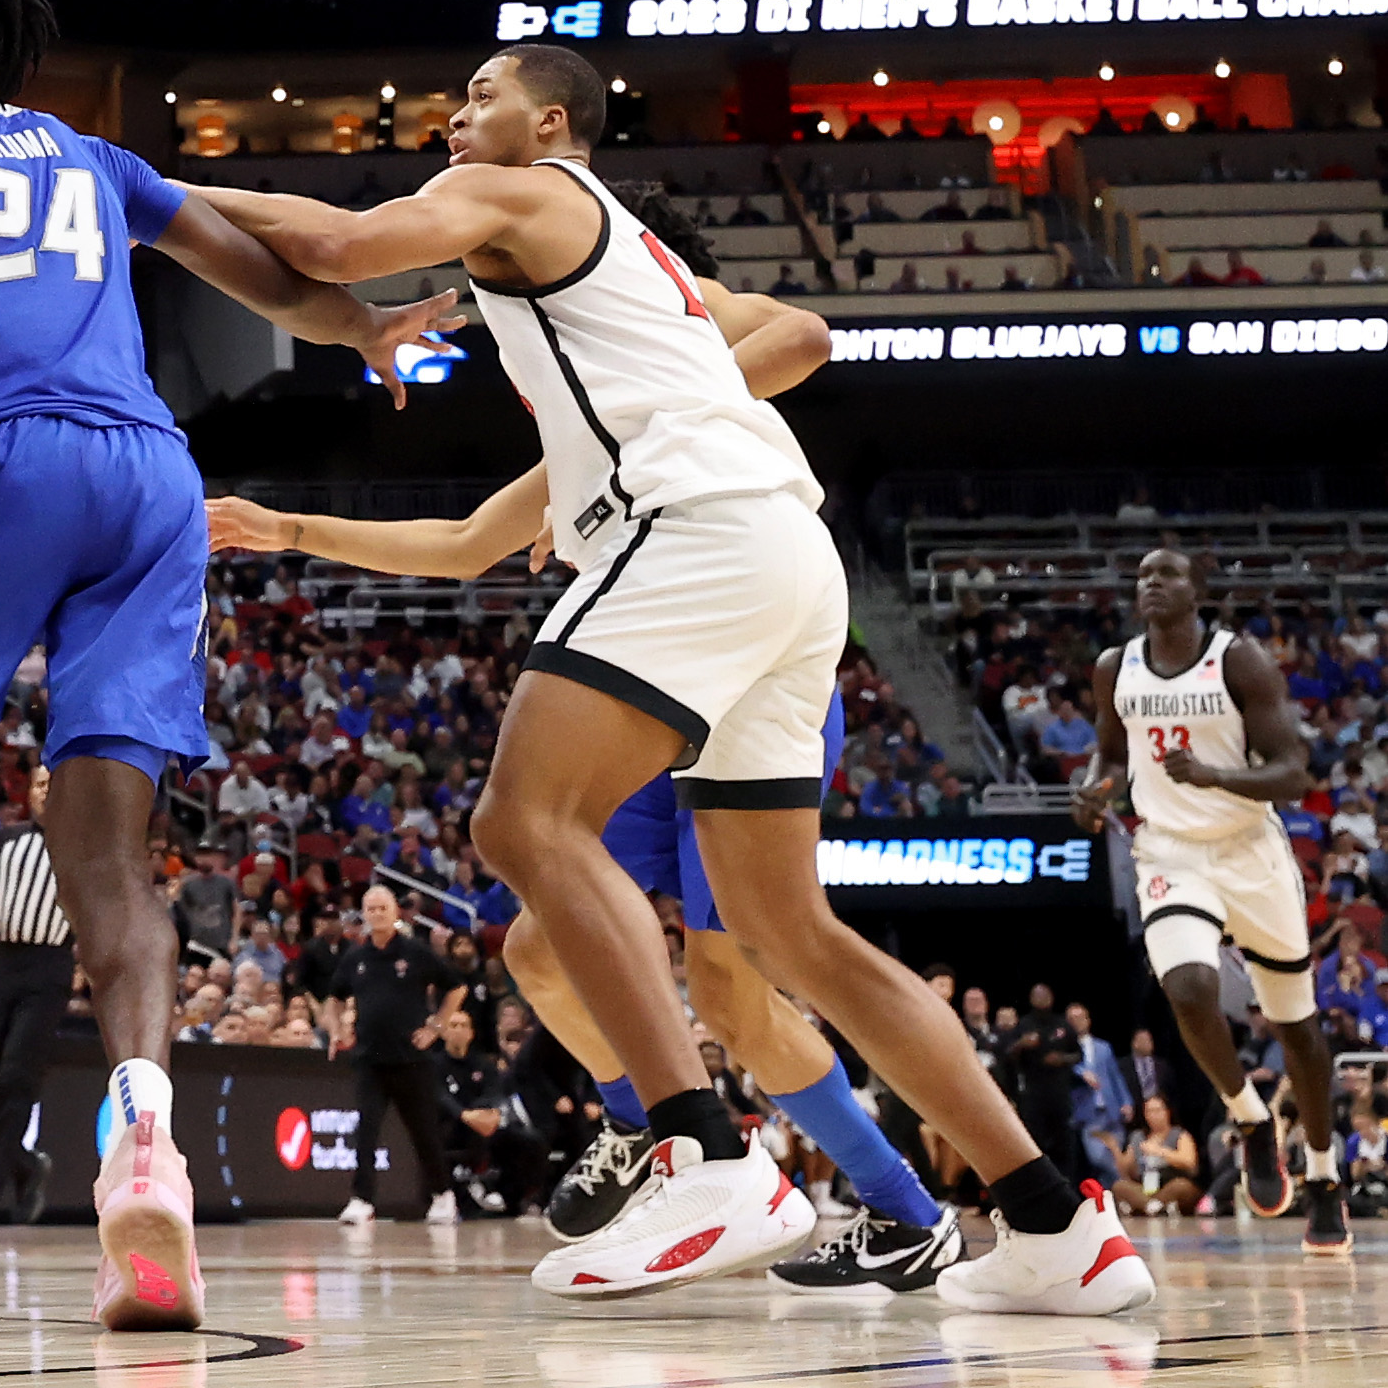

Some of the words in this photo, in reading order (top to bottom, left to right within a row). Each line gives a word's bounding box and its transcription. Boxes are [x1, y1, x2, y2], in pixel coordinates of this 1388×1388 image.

[950, 323, 1126, 360] BLUEJAYS
[1139, 325, 1182, 353] VS
[1187, 321, 1265, 355] SAN
[1270, 318, 1388, 354] DIEGO
[1140, 693, 1180, 718] DIEGO
[1182, 692, 1225, 715] STATE
[1146, 724, 1192, 764] 33
